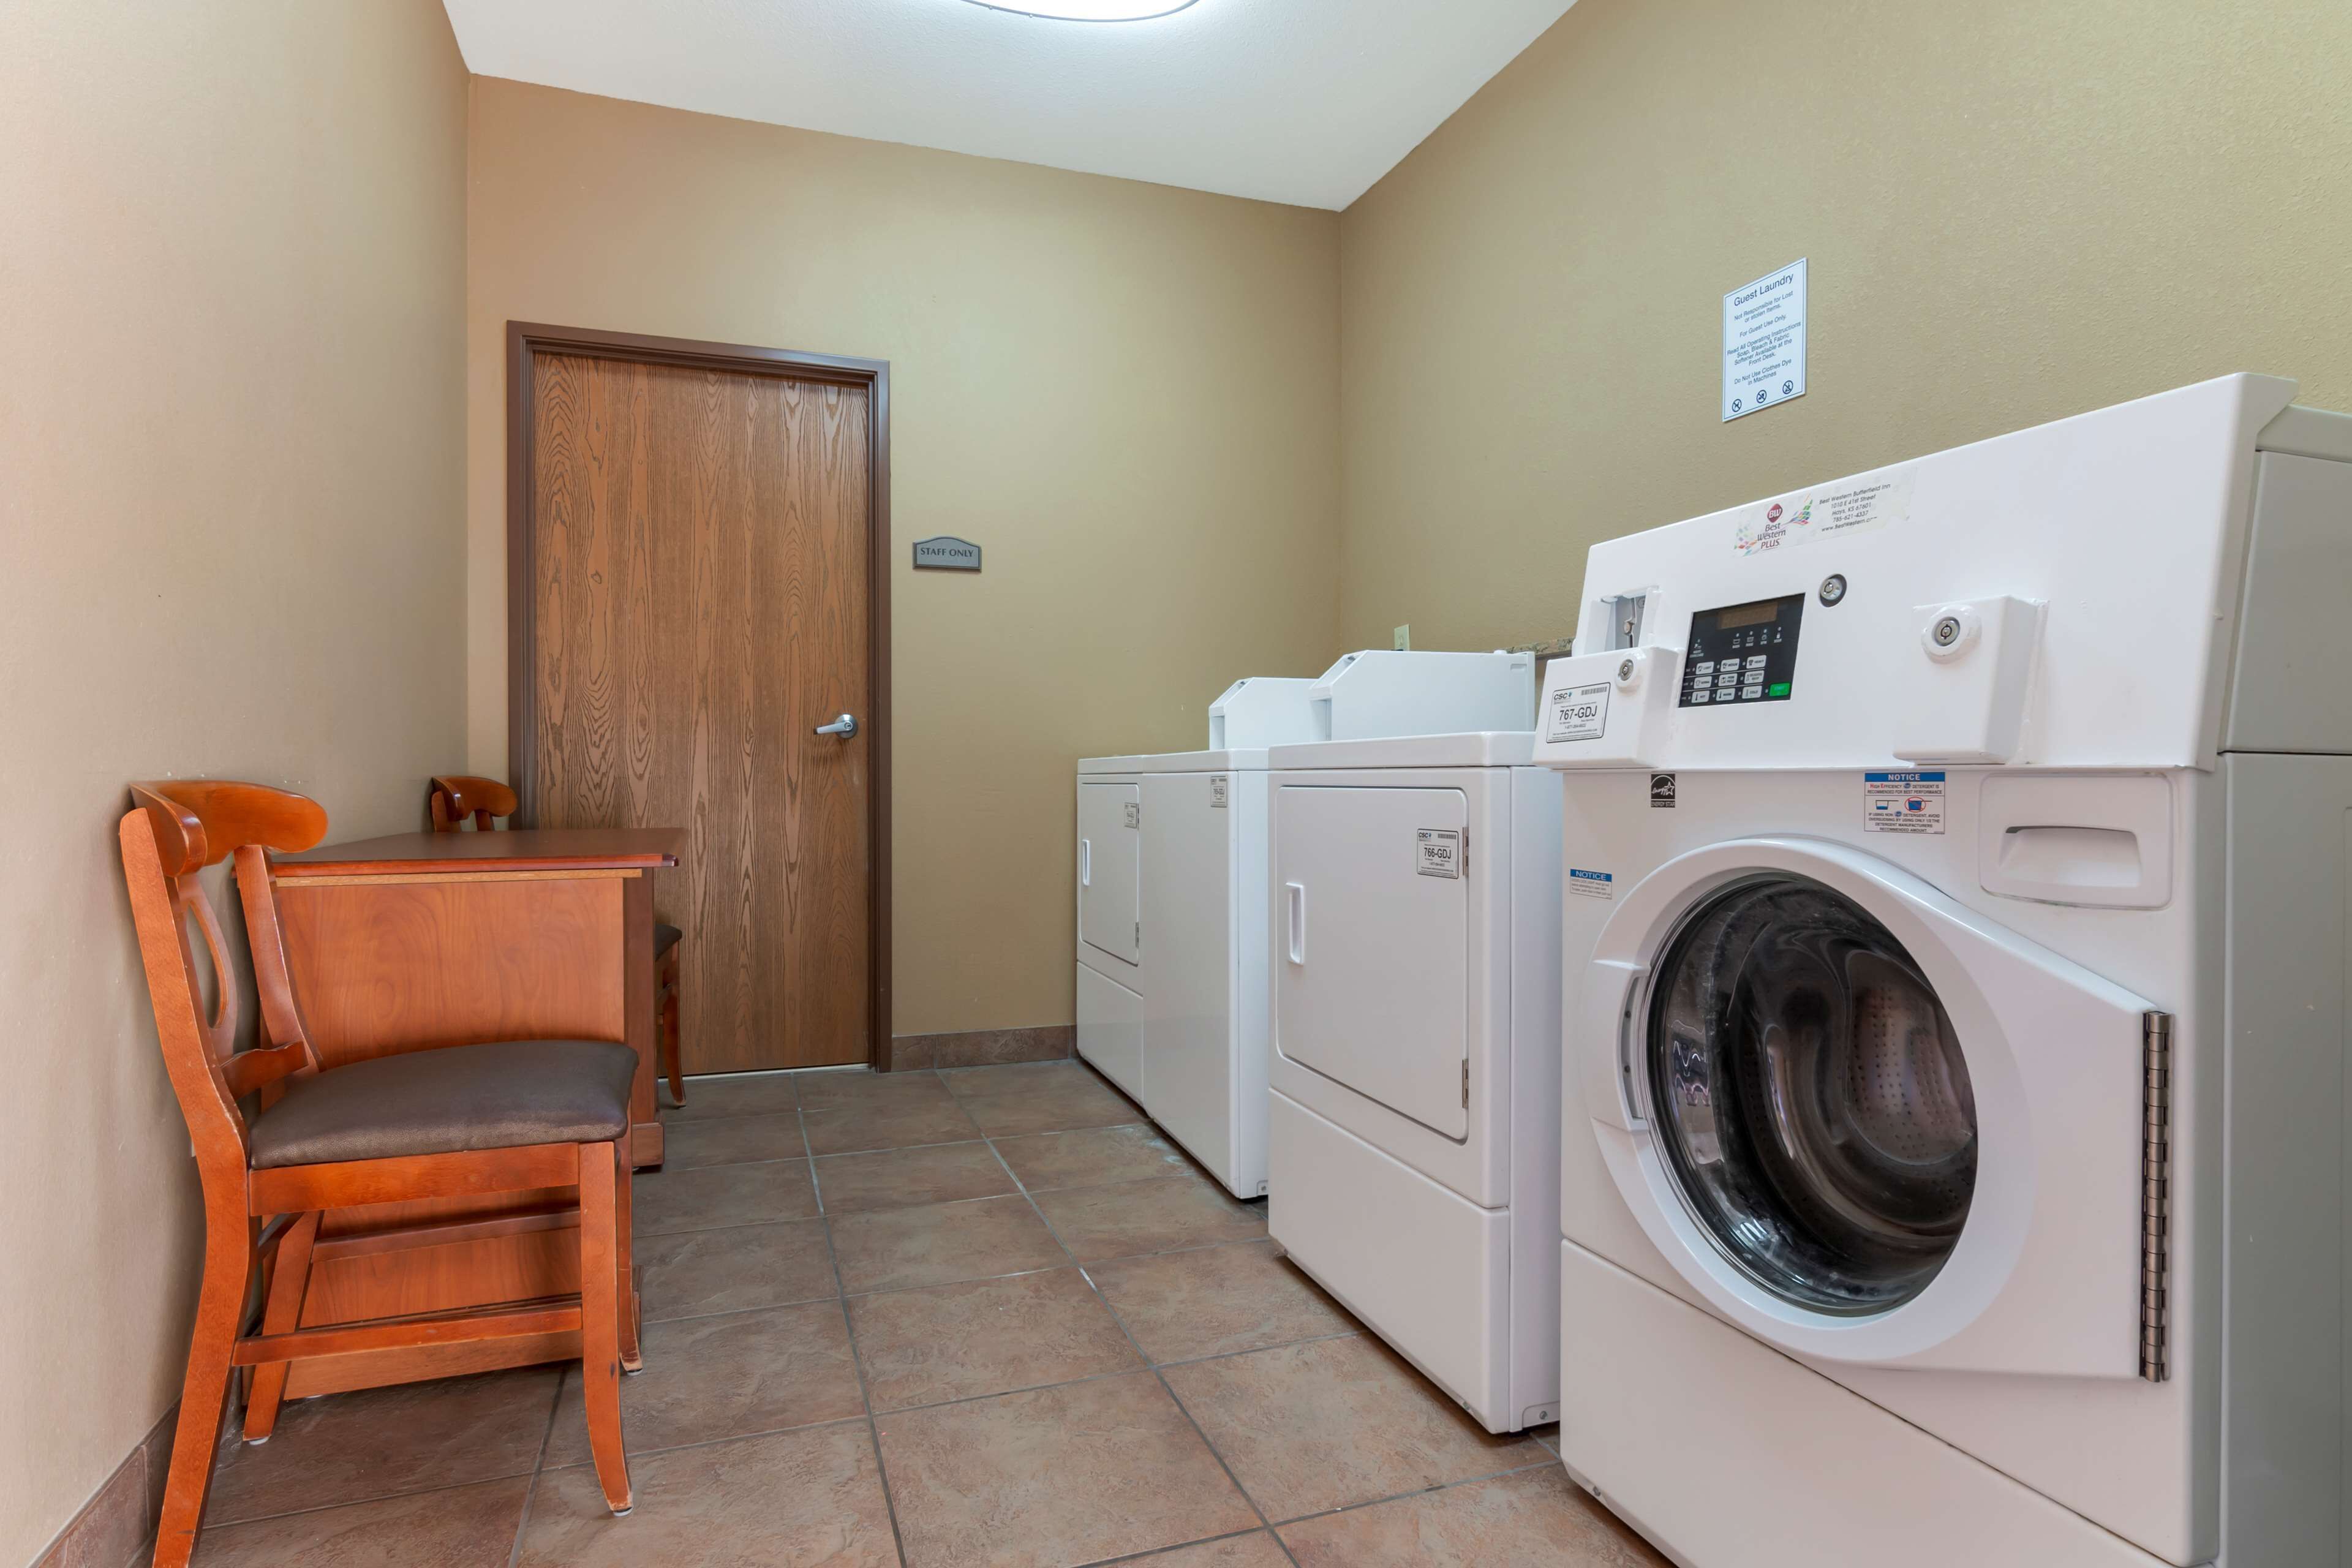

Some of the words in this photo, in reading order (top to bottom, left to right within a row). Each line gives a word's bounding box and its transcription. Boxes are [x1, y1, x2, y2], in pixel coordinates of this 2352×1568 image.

[1734, 289, 1757, 306] Guest
[1760, 273, 1793, 295] Laundry
[1743, 300, 1773, 317] Responsible
[1782, 290, 1793, 300] Lost
[1748, 324, 1763, 334] Guest
[1727, 347, 1740, 356] Read
[1747, 334, 1771, 347] Operating
[1751, 342, 1768, 352] Bleach
[1774, 333, 1790, 343] Fabric
[1734, 353, 1754, 366] Softener
[1755, 345, 1777, 357] Available
[1749, 357, 1762, 366] Front
[1762, 363, 1781, 374] Clothes
[1754, 371, 1776, 383] Machines
[1831, 492, 1852, 502] Western
[1768, 508, 1781, 518] BW
[1765, 522, 1781, 532] Best
[1757, 529, 1786, 541] Western
[1761, 539, 1780, 549] PLUS
[921, 548, 946, 556] STAFF
[949, 549, 974, 557] ONLY
[1559, 706, 1597, 720] 767-GDJ
[1424, 847, 1452, 859] 766-GDJ
[1575, 871, 1607, 880] NOTICE
